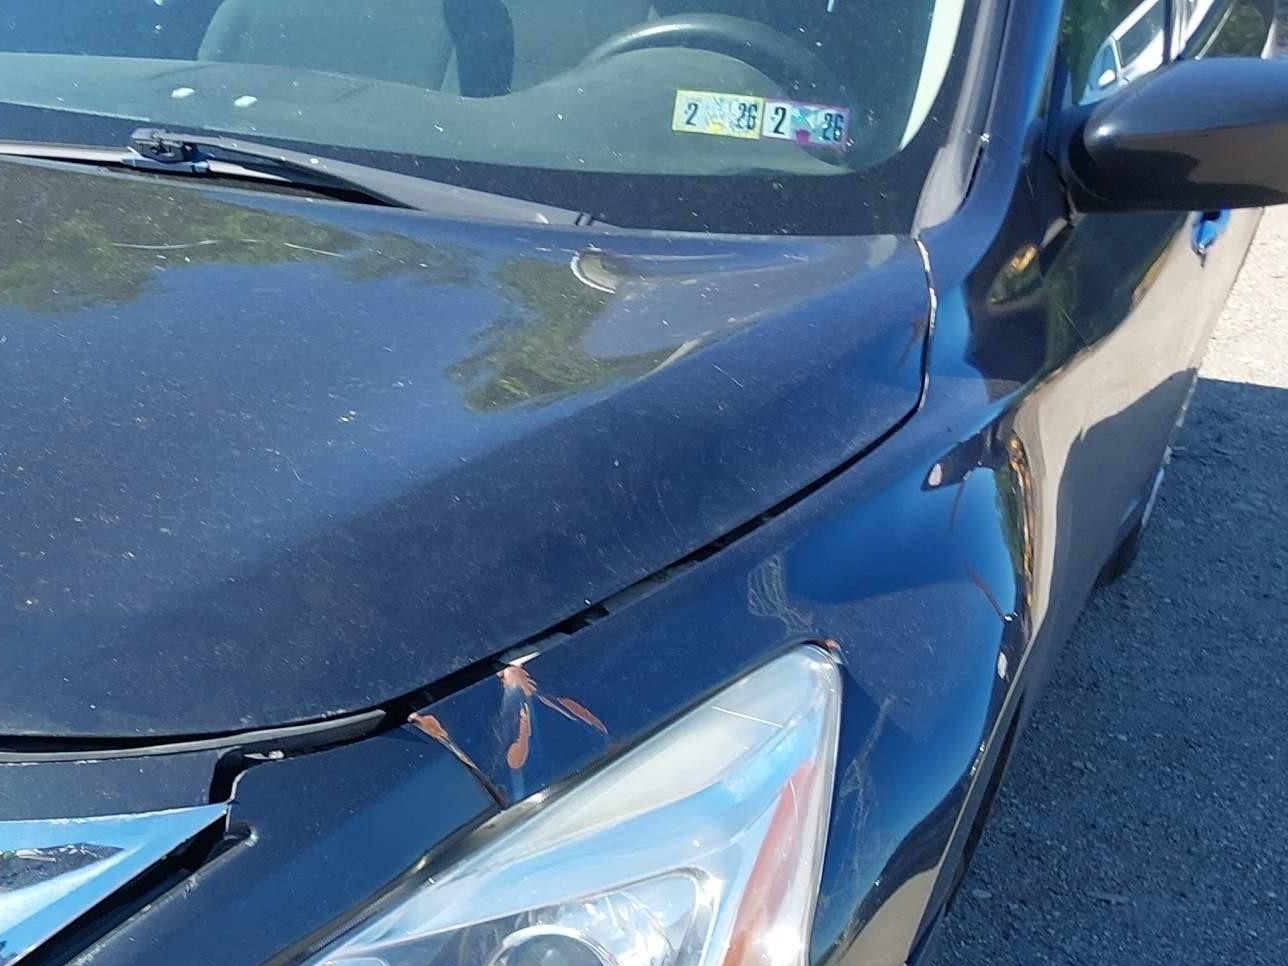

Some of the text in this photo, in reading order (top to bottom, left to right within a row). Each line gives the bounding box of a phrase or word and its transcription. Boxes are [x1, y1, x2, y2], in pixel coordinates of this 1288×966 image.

[685, 102, 758, 130] 2 26
[773, 106, 844, 142] 2 26
